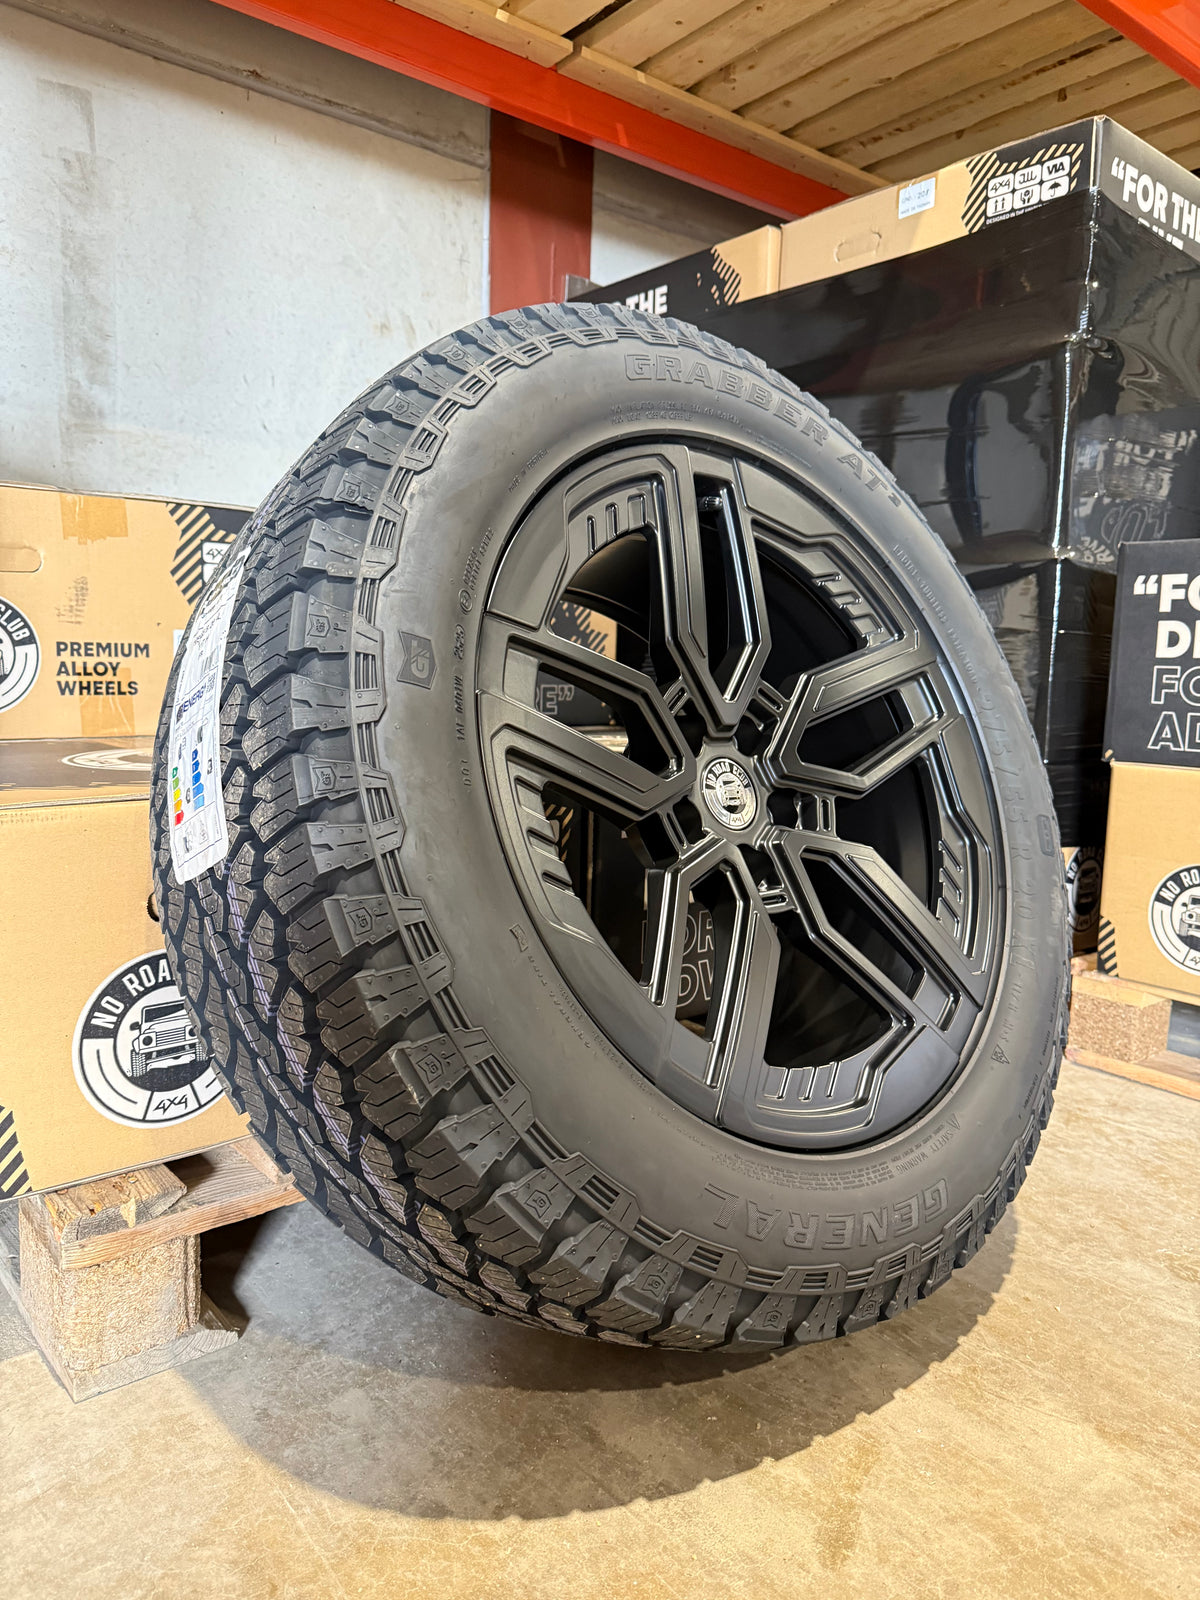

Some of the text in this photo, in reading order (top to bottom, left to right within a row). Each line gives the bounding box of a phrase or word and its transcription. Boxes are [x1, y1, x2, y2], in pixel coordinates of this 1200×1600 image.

[1046, 161, 1065, 176] VIA
[625, 284, 668, 315] THE
[624, 353, 830, 447] GRABBER
[206, 548, 226, 560] 4X
[56, 641, 150, 658] PREMIUM
[1155, 620, 1200, 659] D
[56, 661, 121, 677] ALLOY
[56, 680, 139, 696] WHEELS
[1159, 880, 1180, 901] NO
[90, 958, 174, 1030] NO ROA
[895, 1151, 929, 1175] WARNING
[704, 1177, 950, 1251] GENERAL
